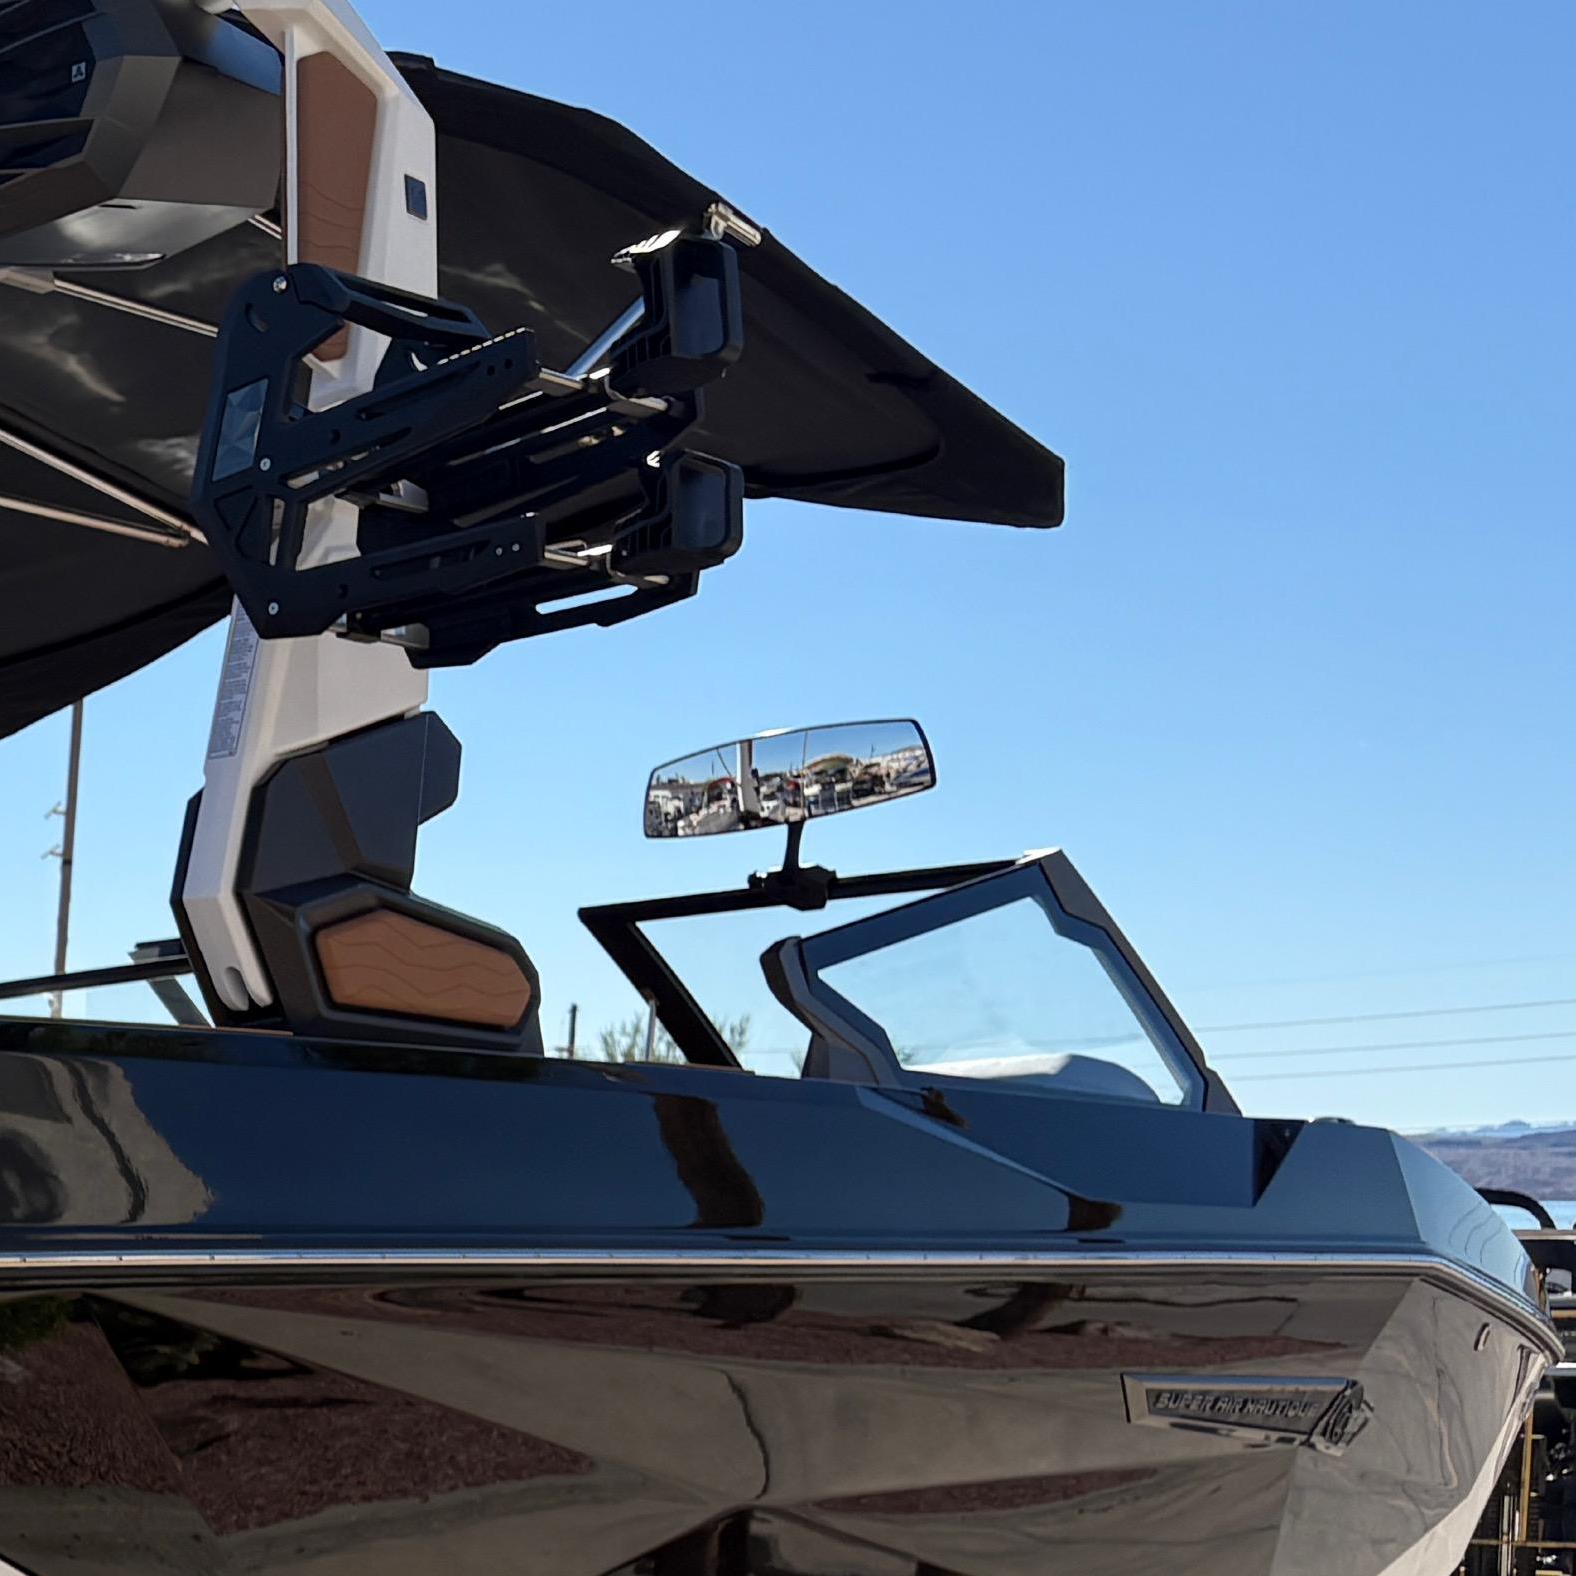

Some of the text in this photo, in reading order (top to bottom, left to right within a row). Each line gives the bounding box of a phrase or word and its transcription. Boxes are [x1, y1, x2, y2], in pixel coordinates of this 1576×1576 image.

[1155, 1392, 1321, 1419] SUPER AIR NAUTIQUE
